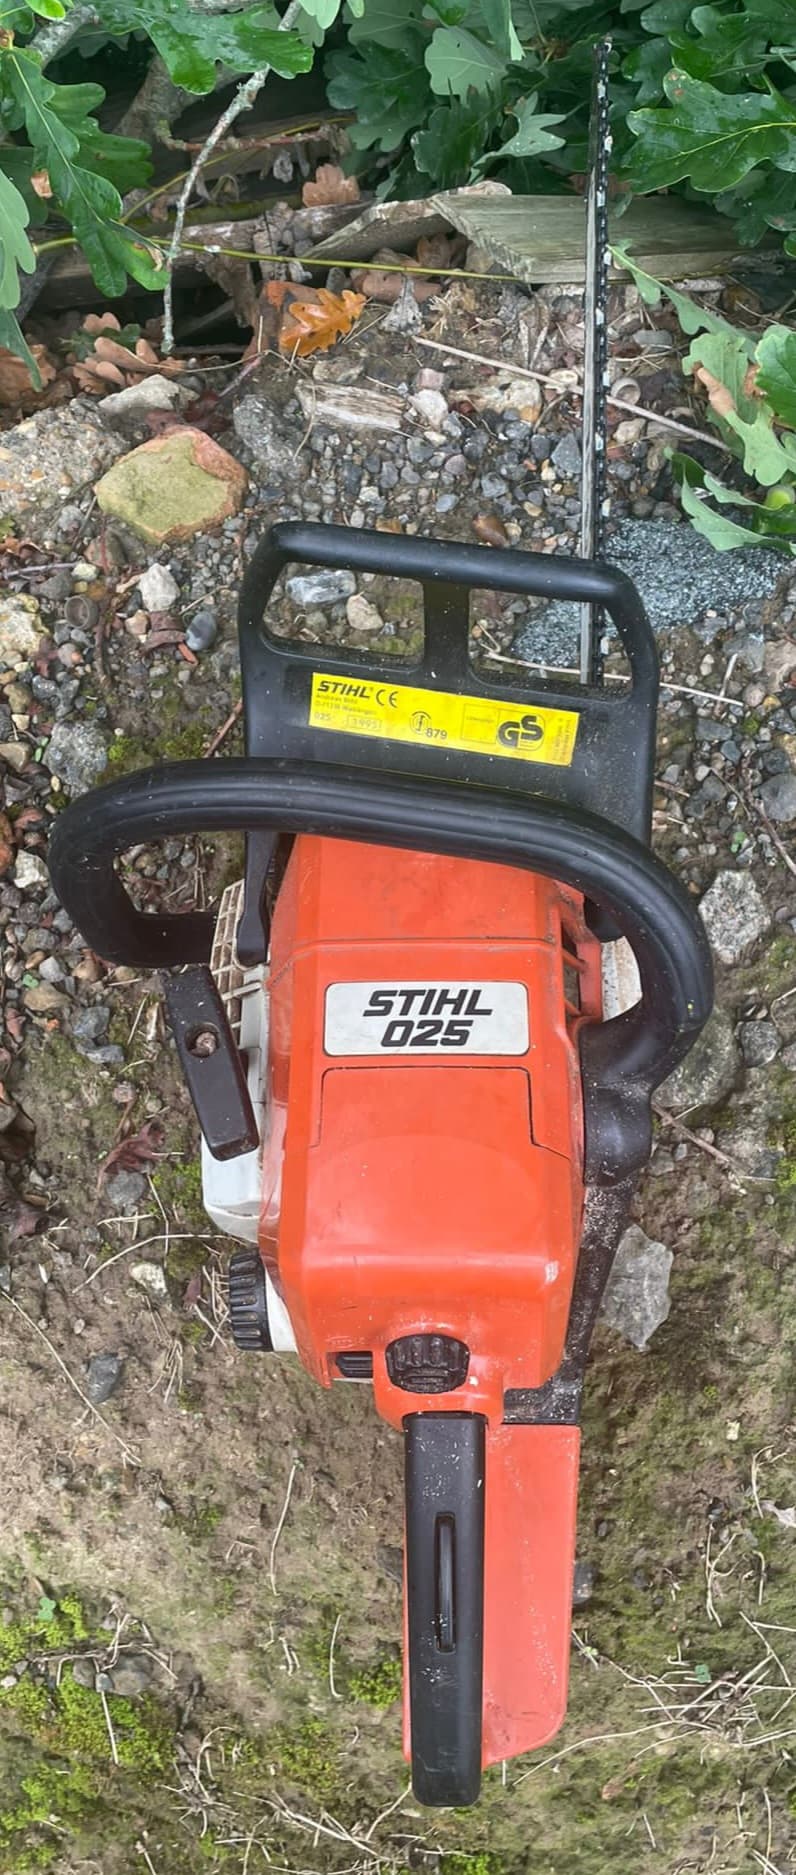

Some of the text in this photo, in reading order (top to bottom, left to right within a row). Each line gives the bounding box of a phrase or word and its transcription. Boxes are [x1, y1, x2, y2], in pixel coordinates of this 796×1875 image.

[317, 680, 399, 708] STIHL CE
[426, 727, 448, 740] 879
[498, 715, 544, 747] GS
[363, 989, 493, 1016] STIHL
[380, 1020, 474, 1047] 025
